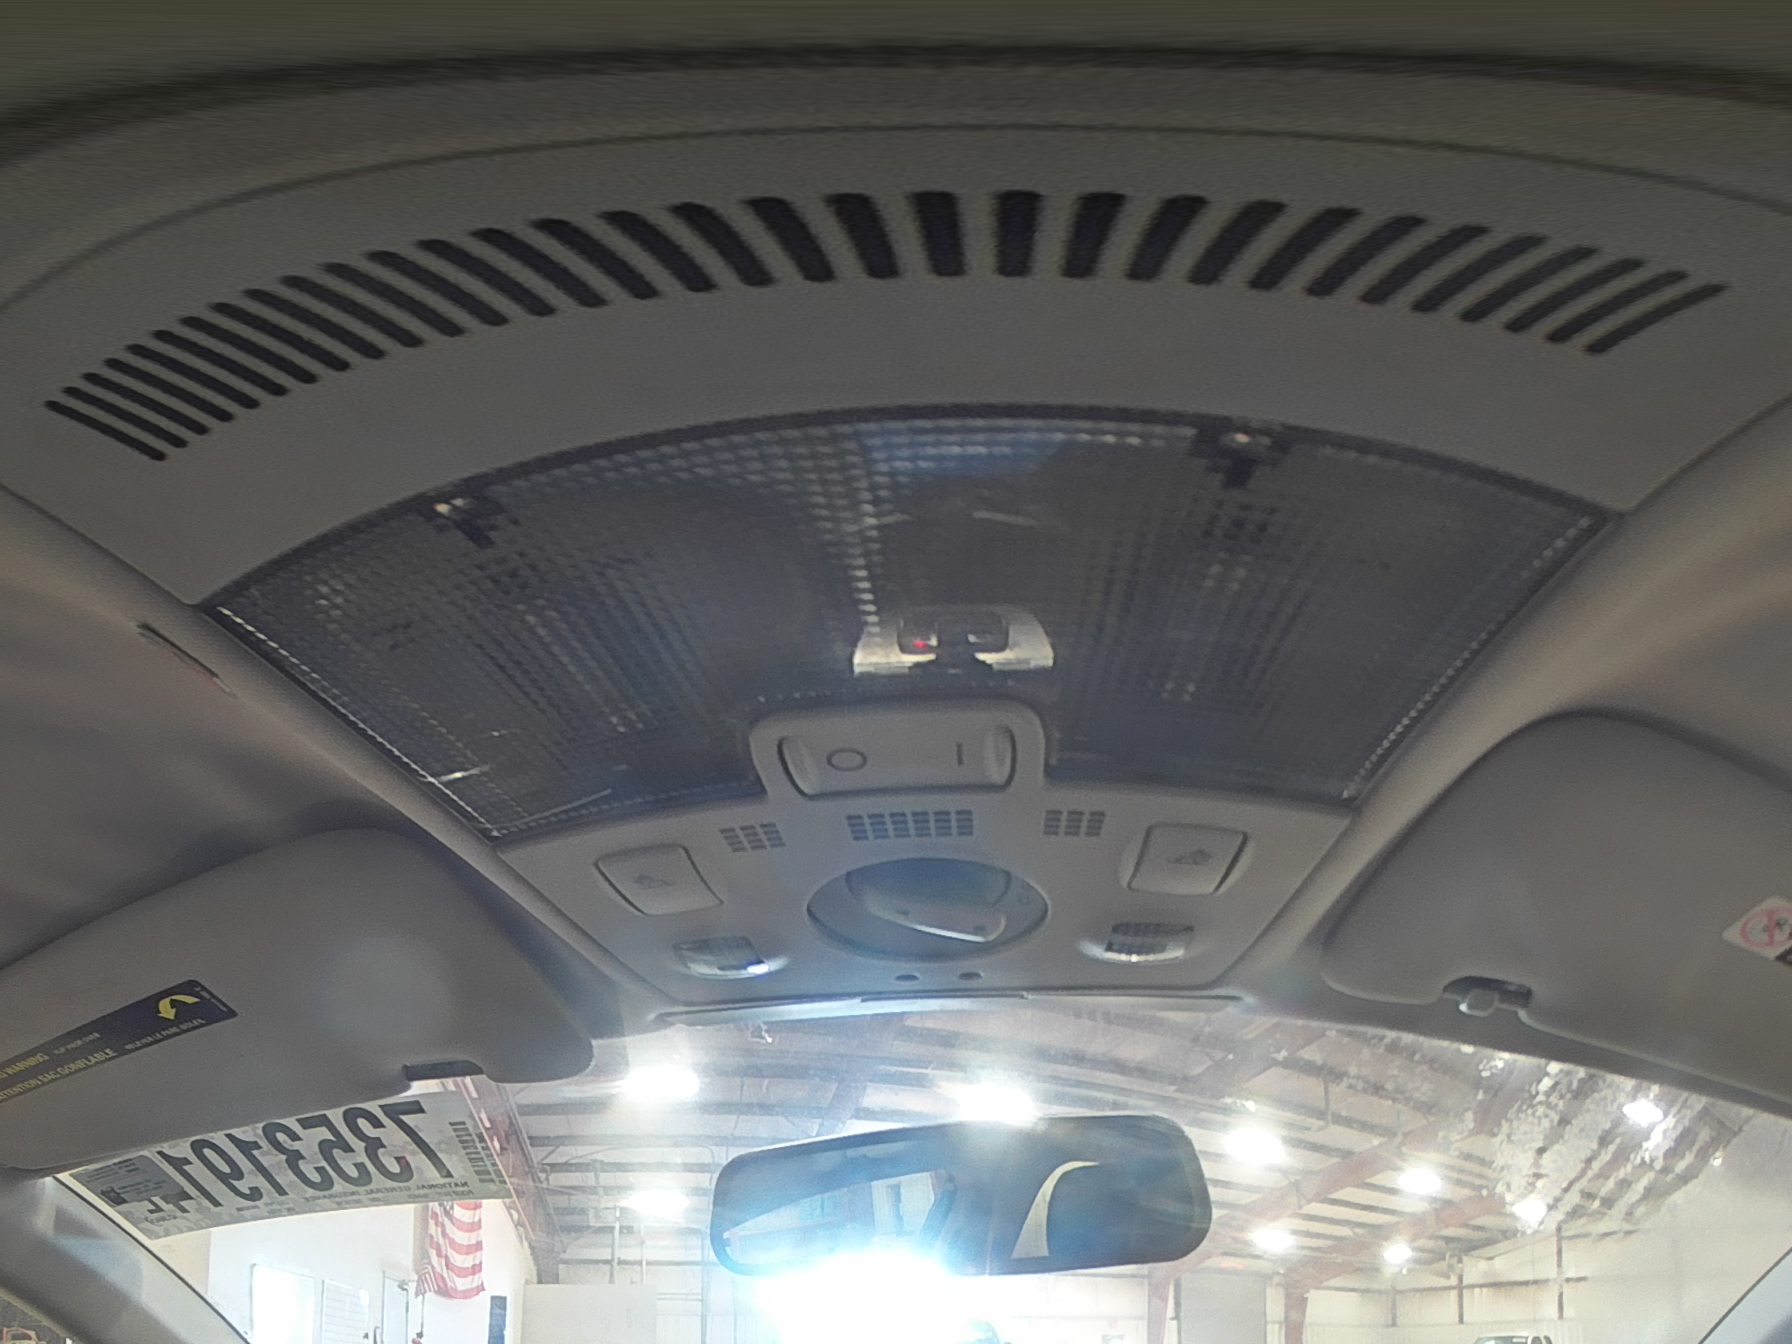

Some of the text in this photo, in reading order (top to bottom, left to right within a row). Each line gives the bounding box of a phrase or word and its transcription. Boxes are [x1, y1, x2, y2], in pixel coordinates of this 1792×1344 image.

[4, 1052, 50, 1077] WARNING
[38, 1070, 61, 1085] SAC
[57, 1047, 119, 1076] GONFLABLE
